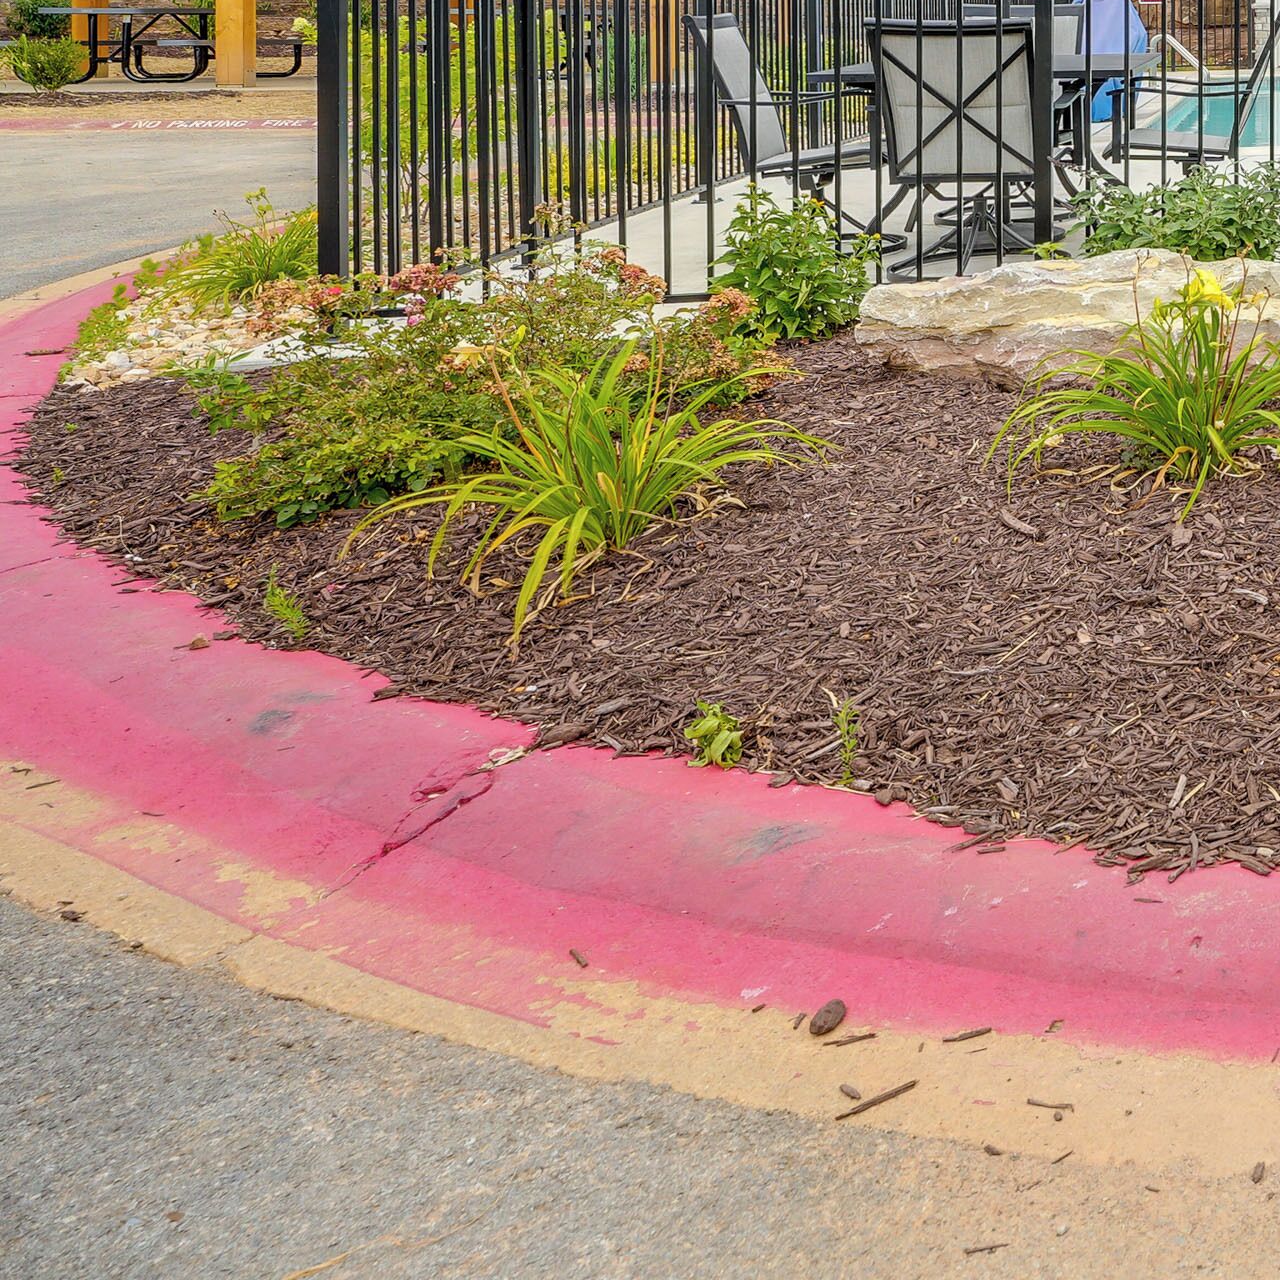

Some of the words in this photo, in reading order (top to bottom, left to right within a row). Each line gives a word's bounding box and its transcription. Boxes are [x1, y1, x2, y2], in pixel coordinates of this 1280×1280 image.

[131, 120, 162, 129] NO
[166, 120, 249, 128] PARKING
[261, 119, 303, 128] FIRE
